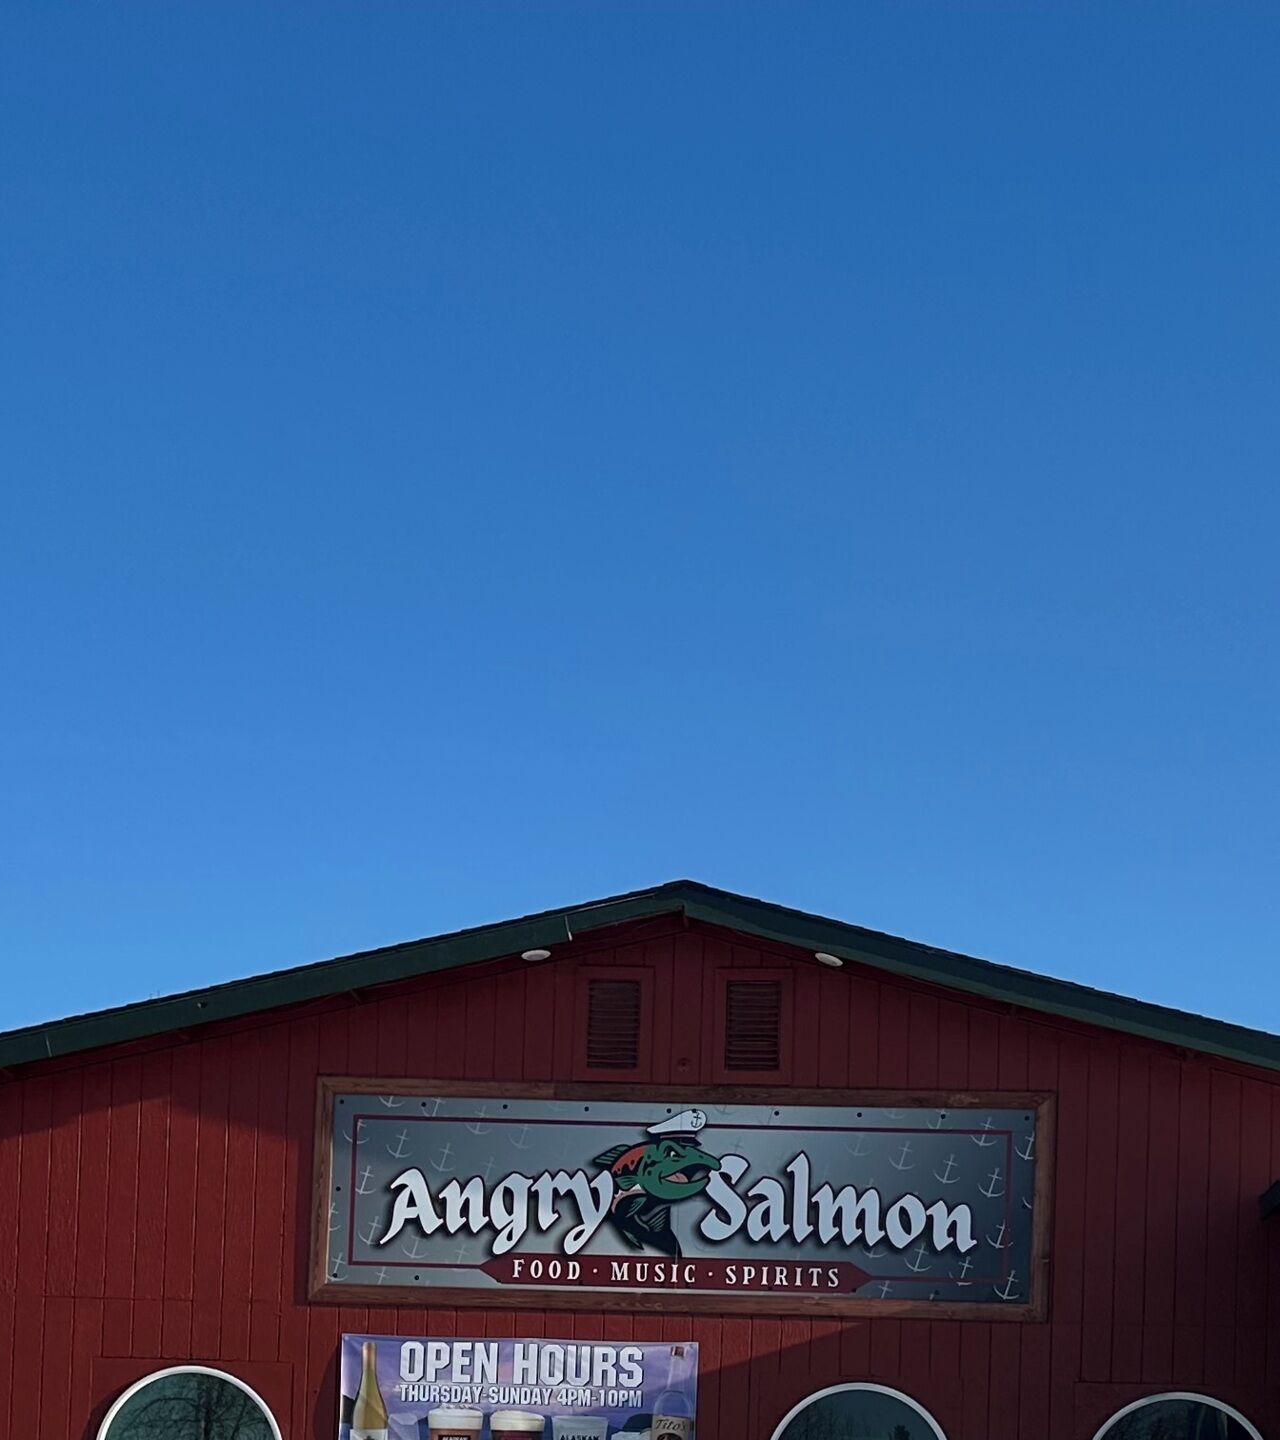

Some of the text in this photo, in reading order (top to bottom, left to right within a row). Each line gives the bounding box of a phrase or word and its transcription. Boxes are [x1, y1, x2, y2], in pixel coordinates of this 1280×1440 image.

[379, 1151, 978, 1254] Angry Salmon
[512, 1259, 839, 1287] FOOD MUSIC SPIRITS
[399, 1341, 644, 1388] OPEN HOURS
[400, 1384, 643, 1408] THURSDAY-SUNDAY 4PM-10PM
